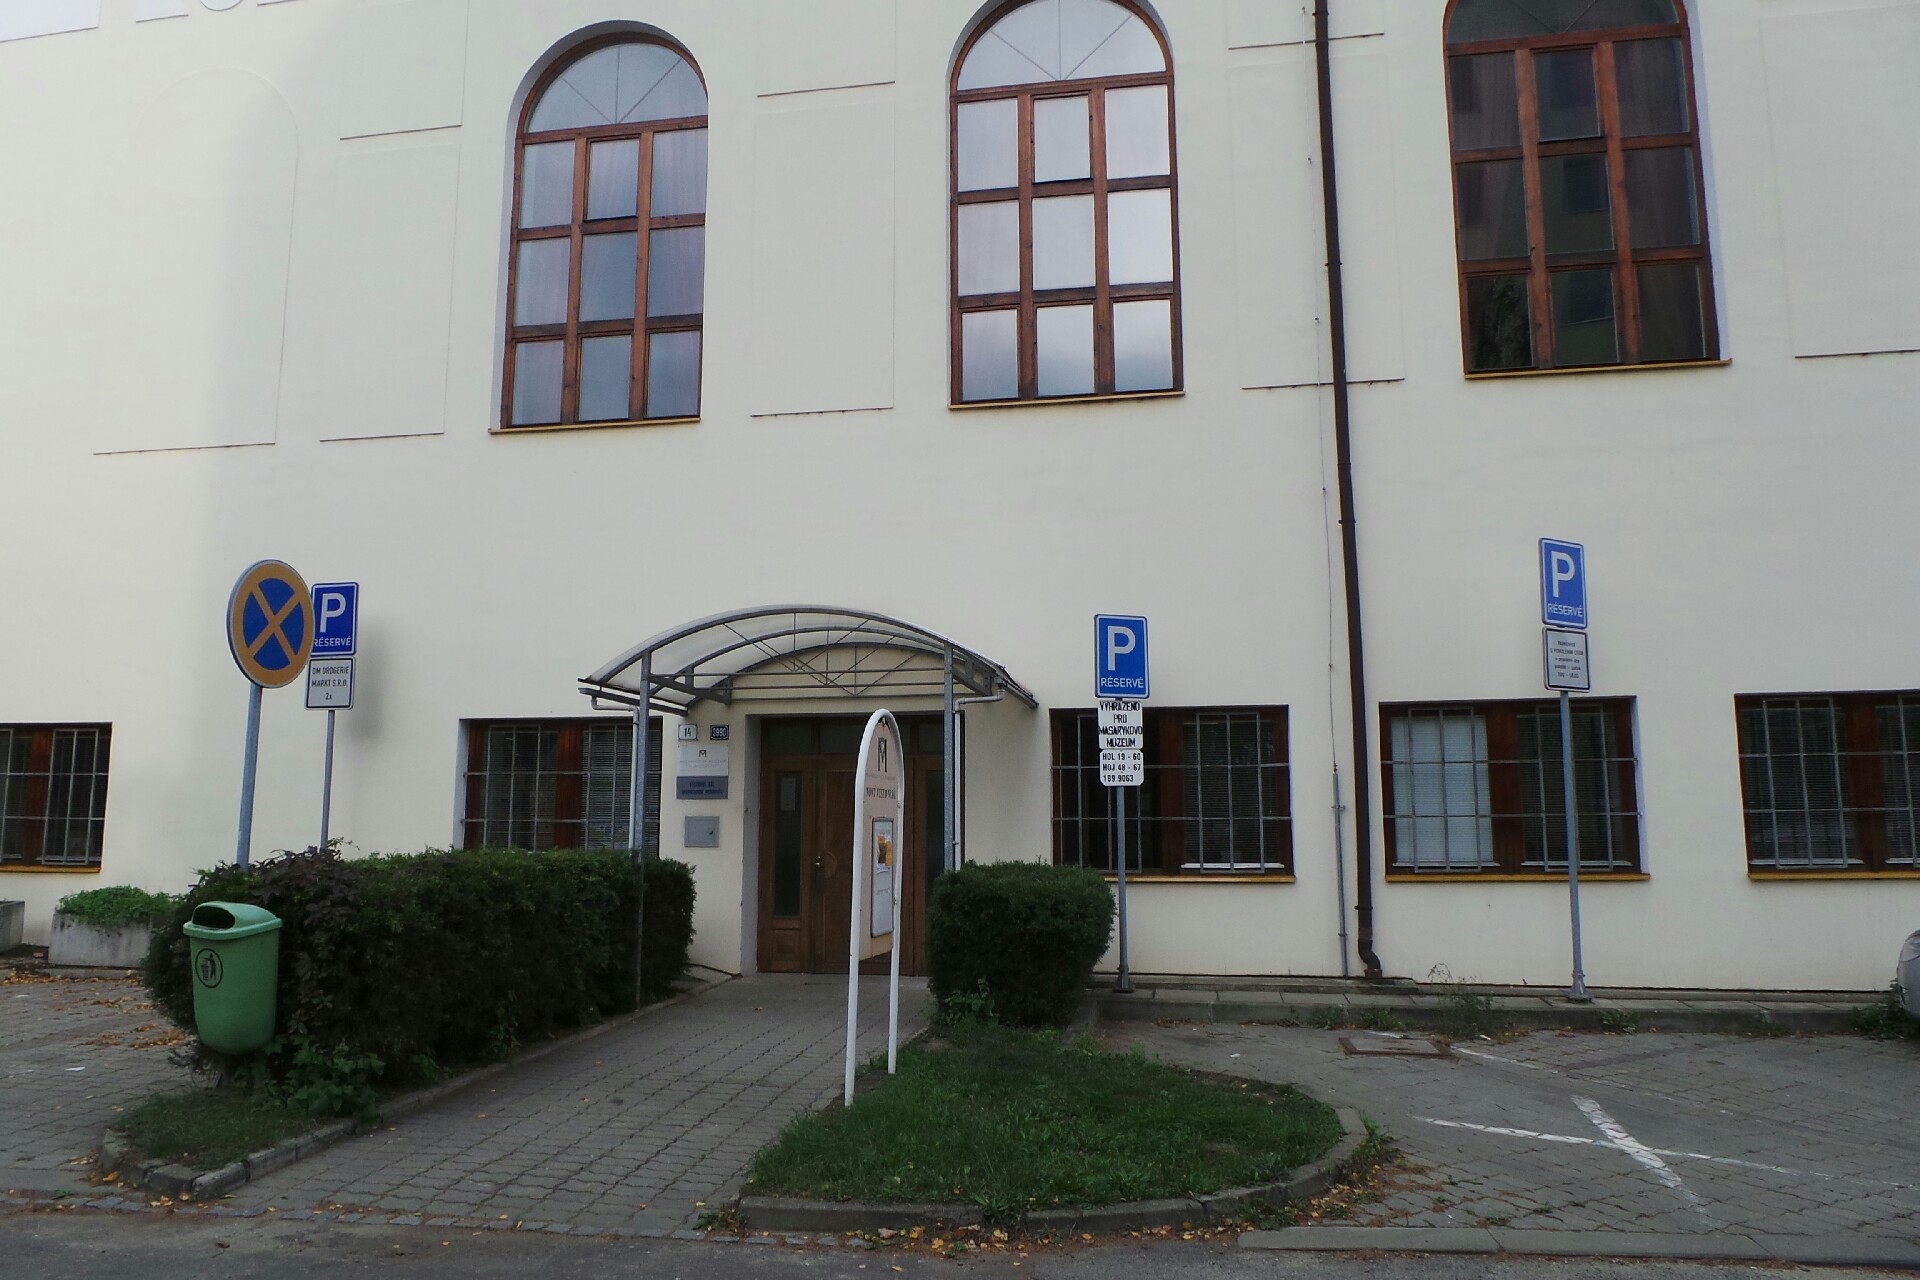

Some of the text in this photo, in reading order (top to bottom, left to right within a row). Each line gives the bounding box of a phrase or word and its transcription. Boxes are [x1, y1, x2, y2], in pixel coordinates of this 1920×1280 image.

[1551, 551, 1576, 598] P
[319, 592, 346, 633] P
[1547, 602, 1584, 618] RÉSERVÉ
[1107, 625, 1136, 671] P
[322, 666, 350, 675] DROGERIE
[311, 679, 331, 687] MARKT
[1101, 676, 1144, 688] RÉSERVÉ
[1099, 701, 1141, 712] VYHRAZENO
[1113, 714, 1128, 724] PRO
[684, 727, 692, 737] 14
[1098, 725, 1143, 735] MASARYKOVO
[1106, 738, 1136, 747] MUZEUM
[1102, 752, 1115, 760] HOL
[1117, 752, 1125, 760] 19
